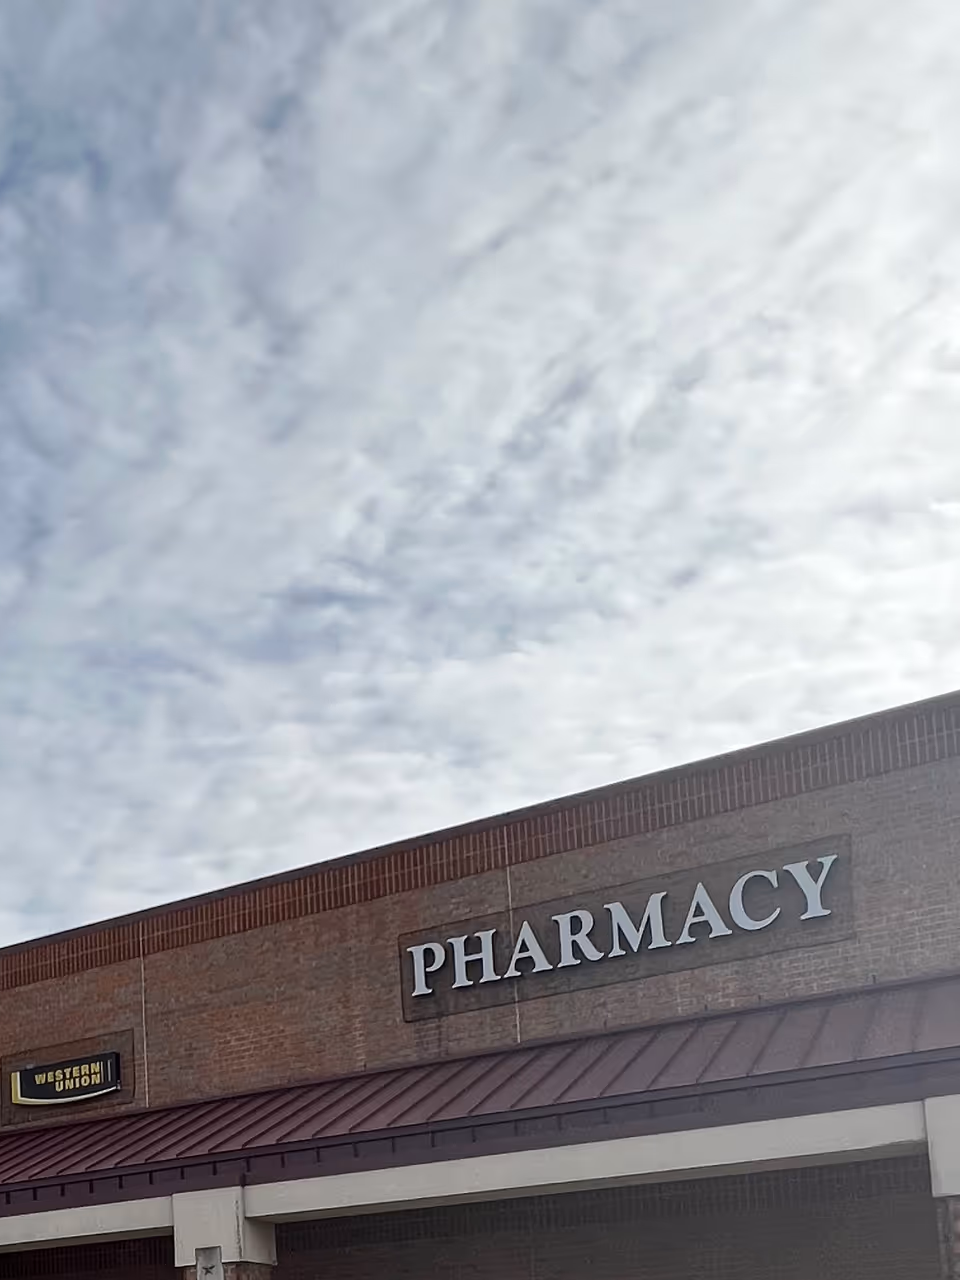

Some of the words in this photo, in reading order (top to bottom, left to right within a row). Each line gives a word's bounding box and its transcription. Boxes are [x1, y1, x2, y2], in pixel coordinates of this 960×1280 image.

[406, 854, 838, 997] PHARMACY
[35, 1061, 100, 1085] WESTERN
[55, 1073, 101, 1092] UNION
